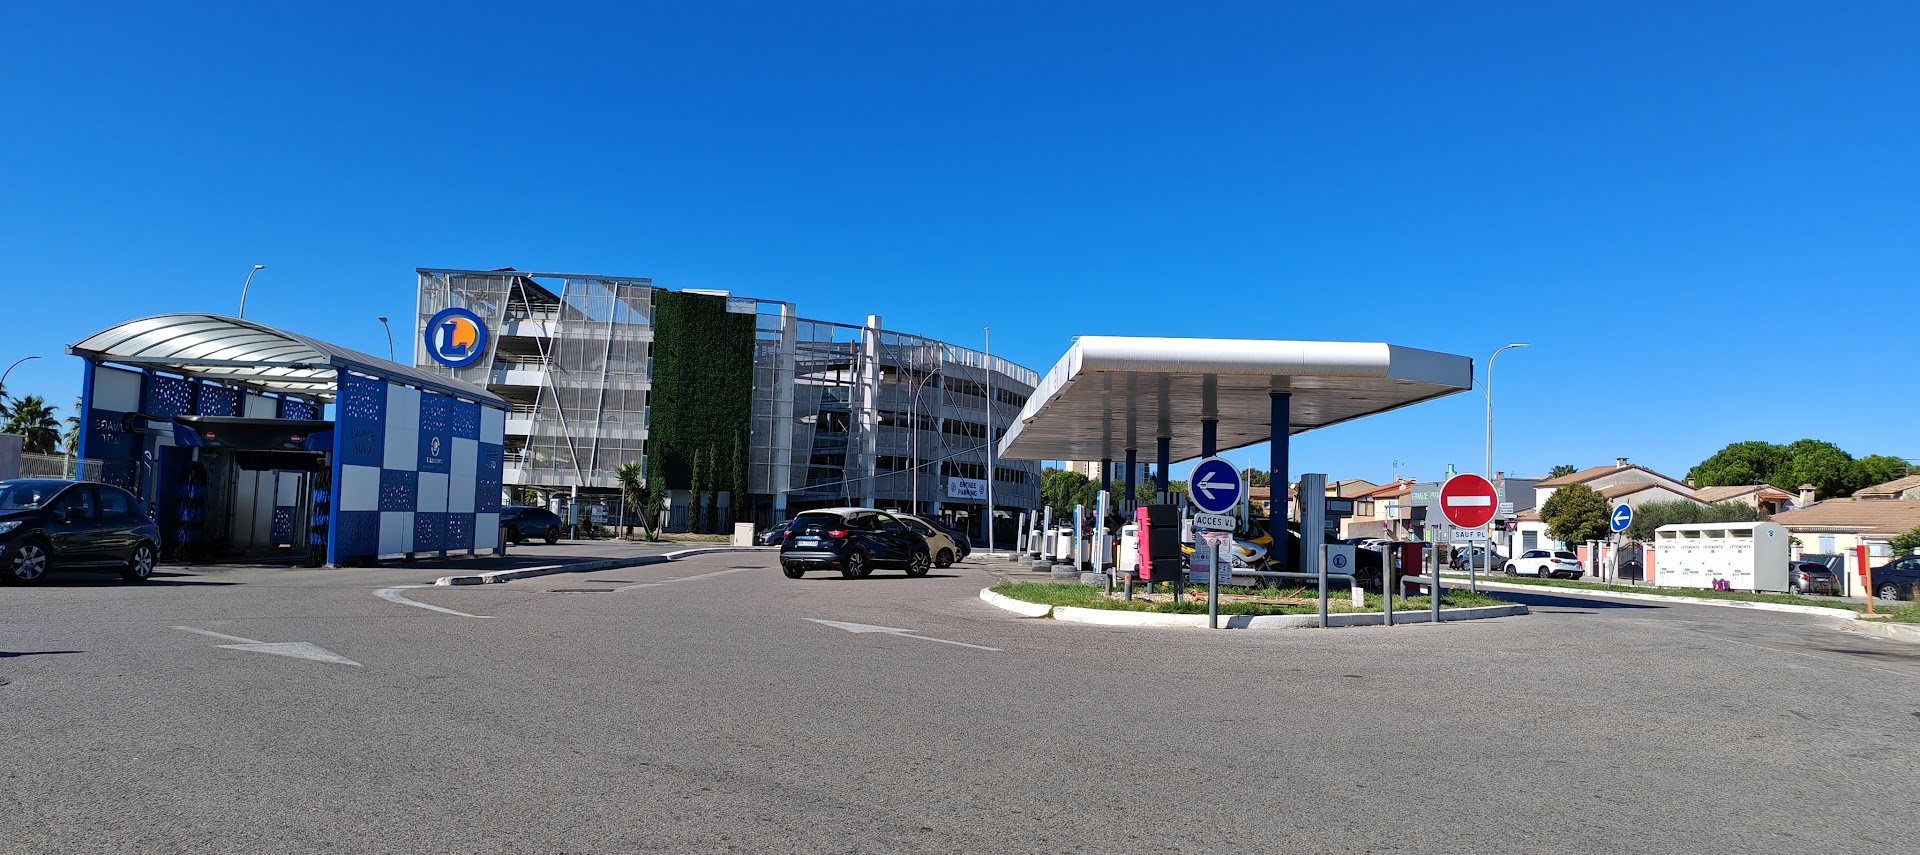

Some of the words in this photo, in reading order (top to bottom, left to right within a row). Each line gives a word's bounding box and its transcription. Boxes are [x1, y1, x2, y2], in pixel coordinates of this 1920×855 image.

[440, 323, 467, 357] L
[959, 480, 977, 489] ENTRÉE
[957, 489, 977, 497] PARKING
[1411, 492, 1428, 501] GRANDE
[1196, 516, 1222, 526] ACCES
[1225, 518, 1234, 528] VL
[1336, 557, 1343, 566] L
